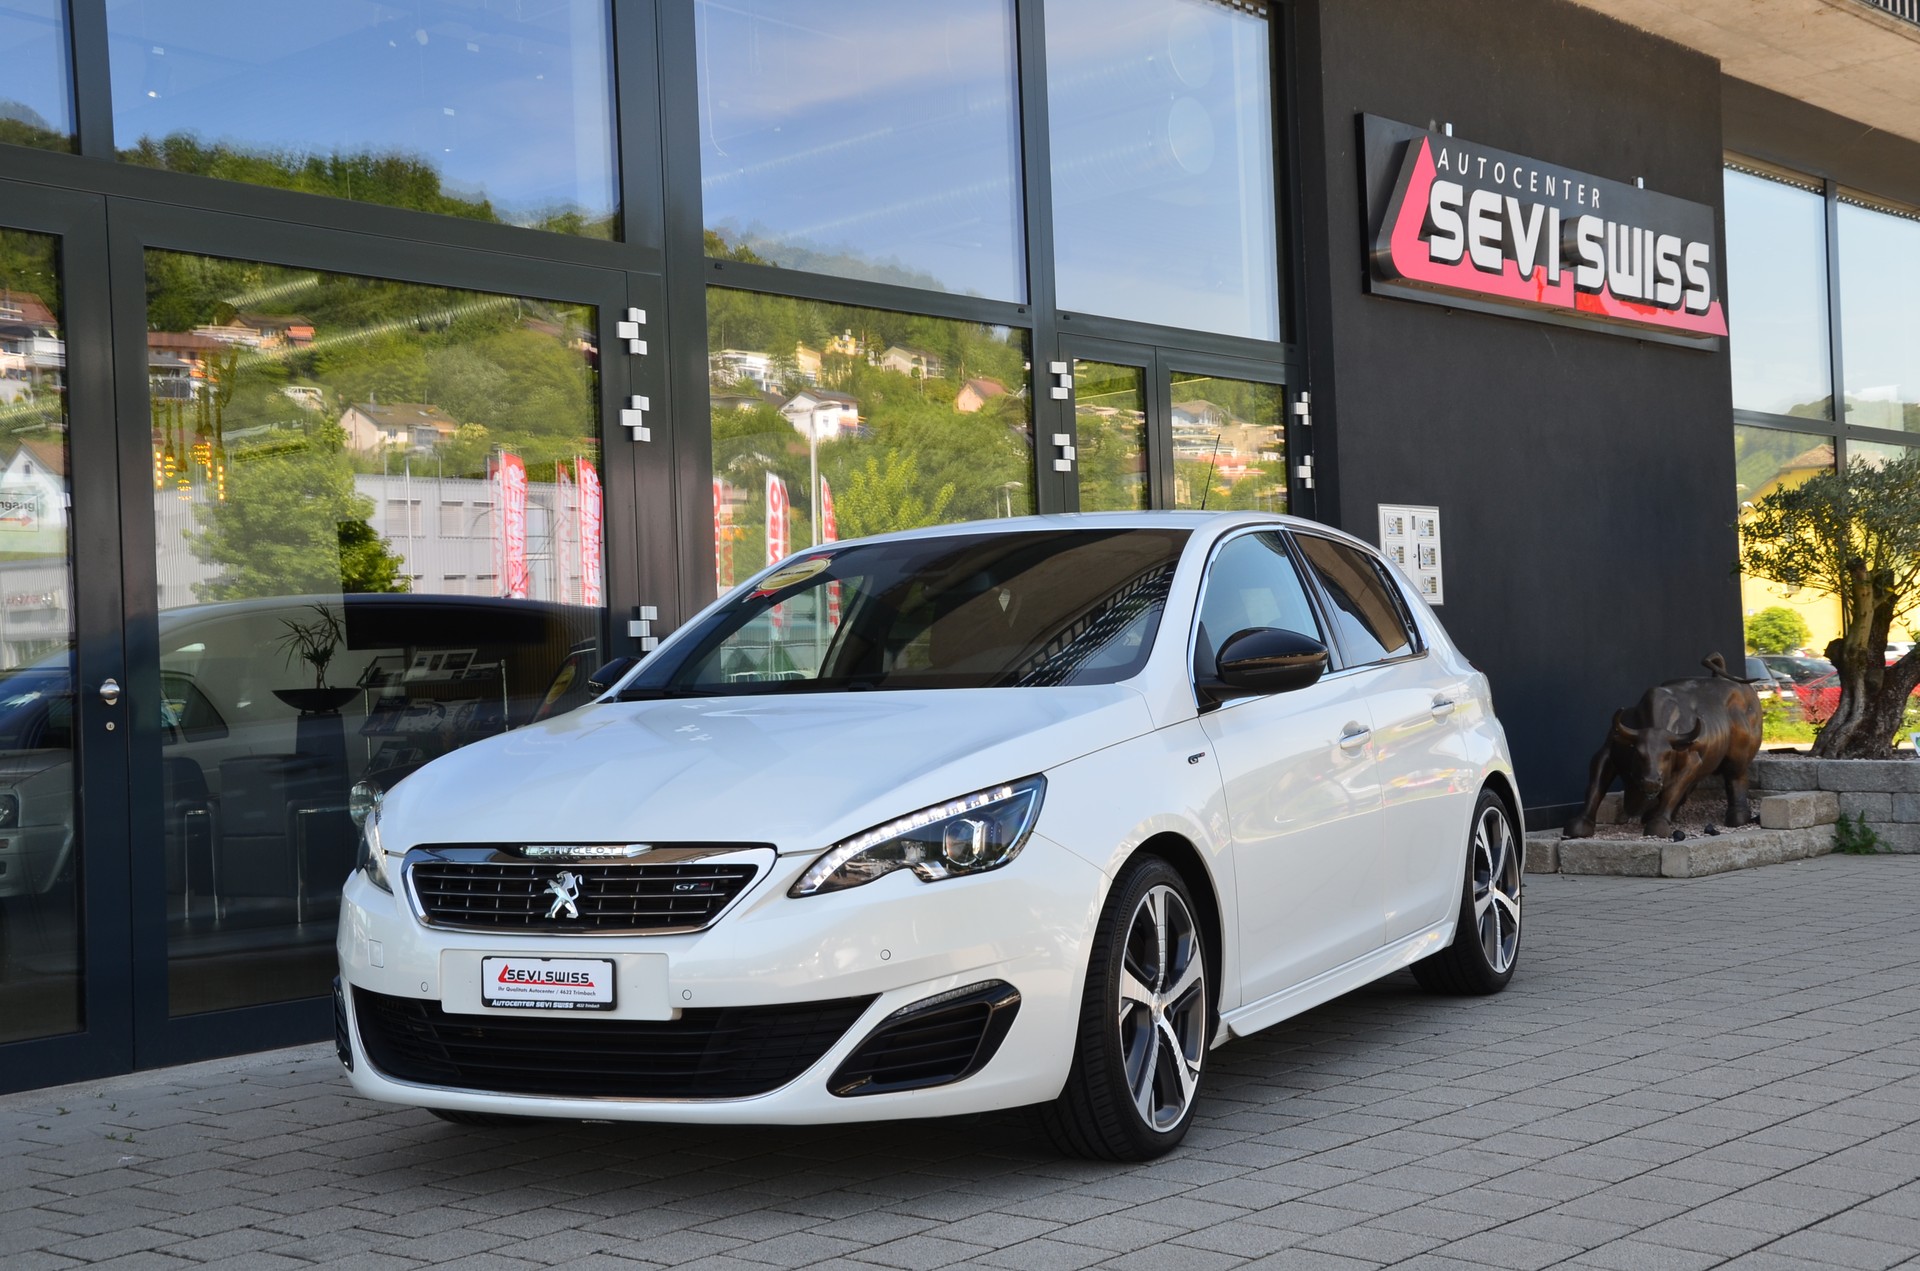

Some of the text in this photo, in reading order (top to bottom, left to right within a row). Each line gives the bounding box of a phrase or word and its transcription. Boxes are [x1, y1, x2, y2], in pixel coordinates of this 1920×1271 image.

[1437, 147, 1601, 210] AUTOCENTER
[1429, 179, 1711, 311] SEVI SWISS
[538, 846, 616, 855] PEUGEOT
[675, 883, 699, 891] GT
[507, 969, 589, 984] SEVI SWISS
